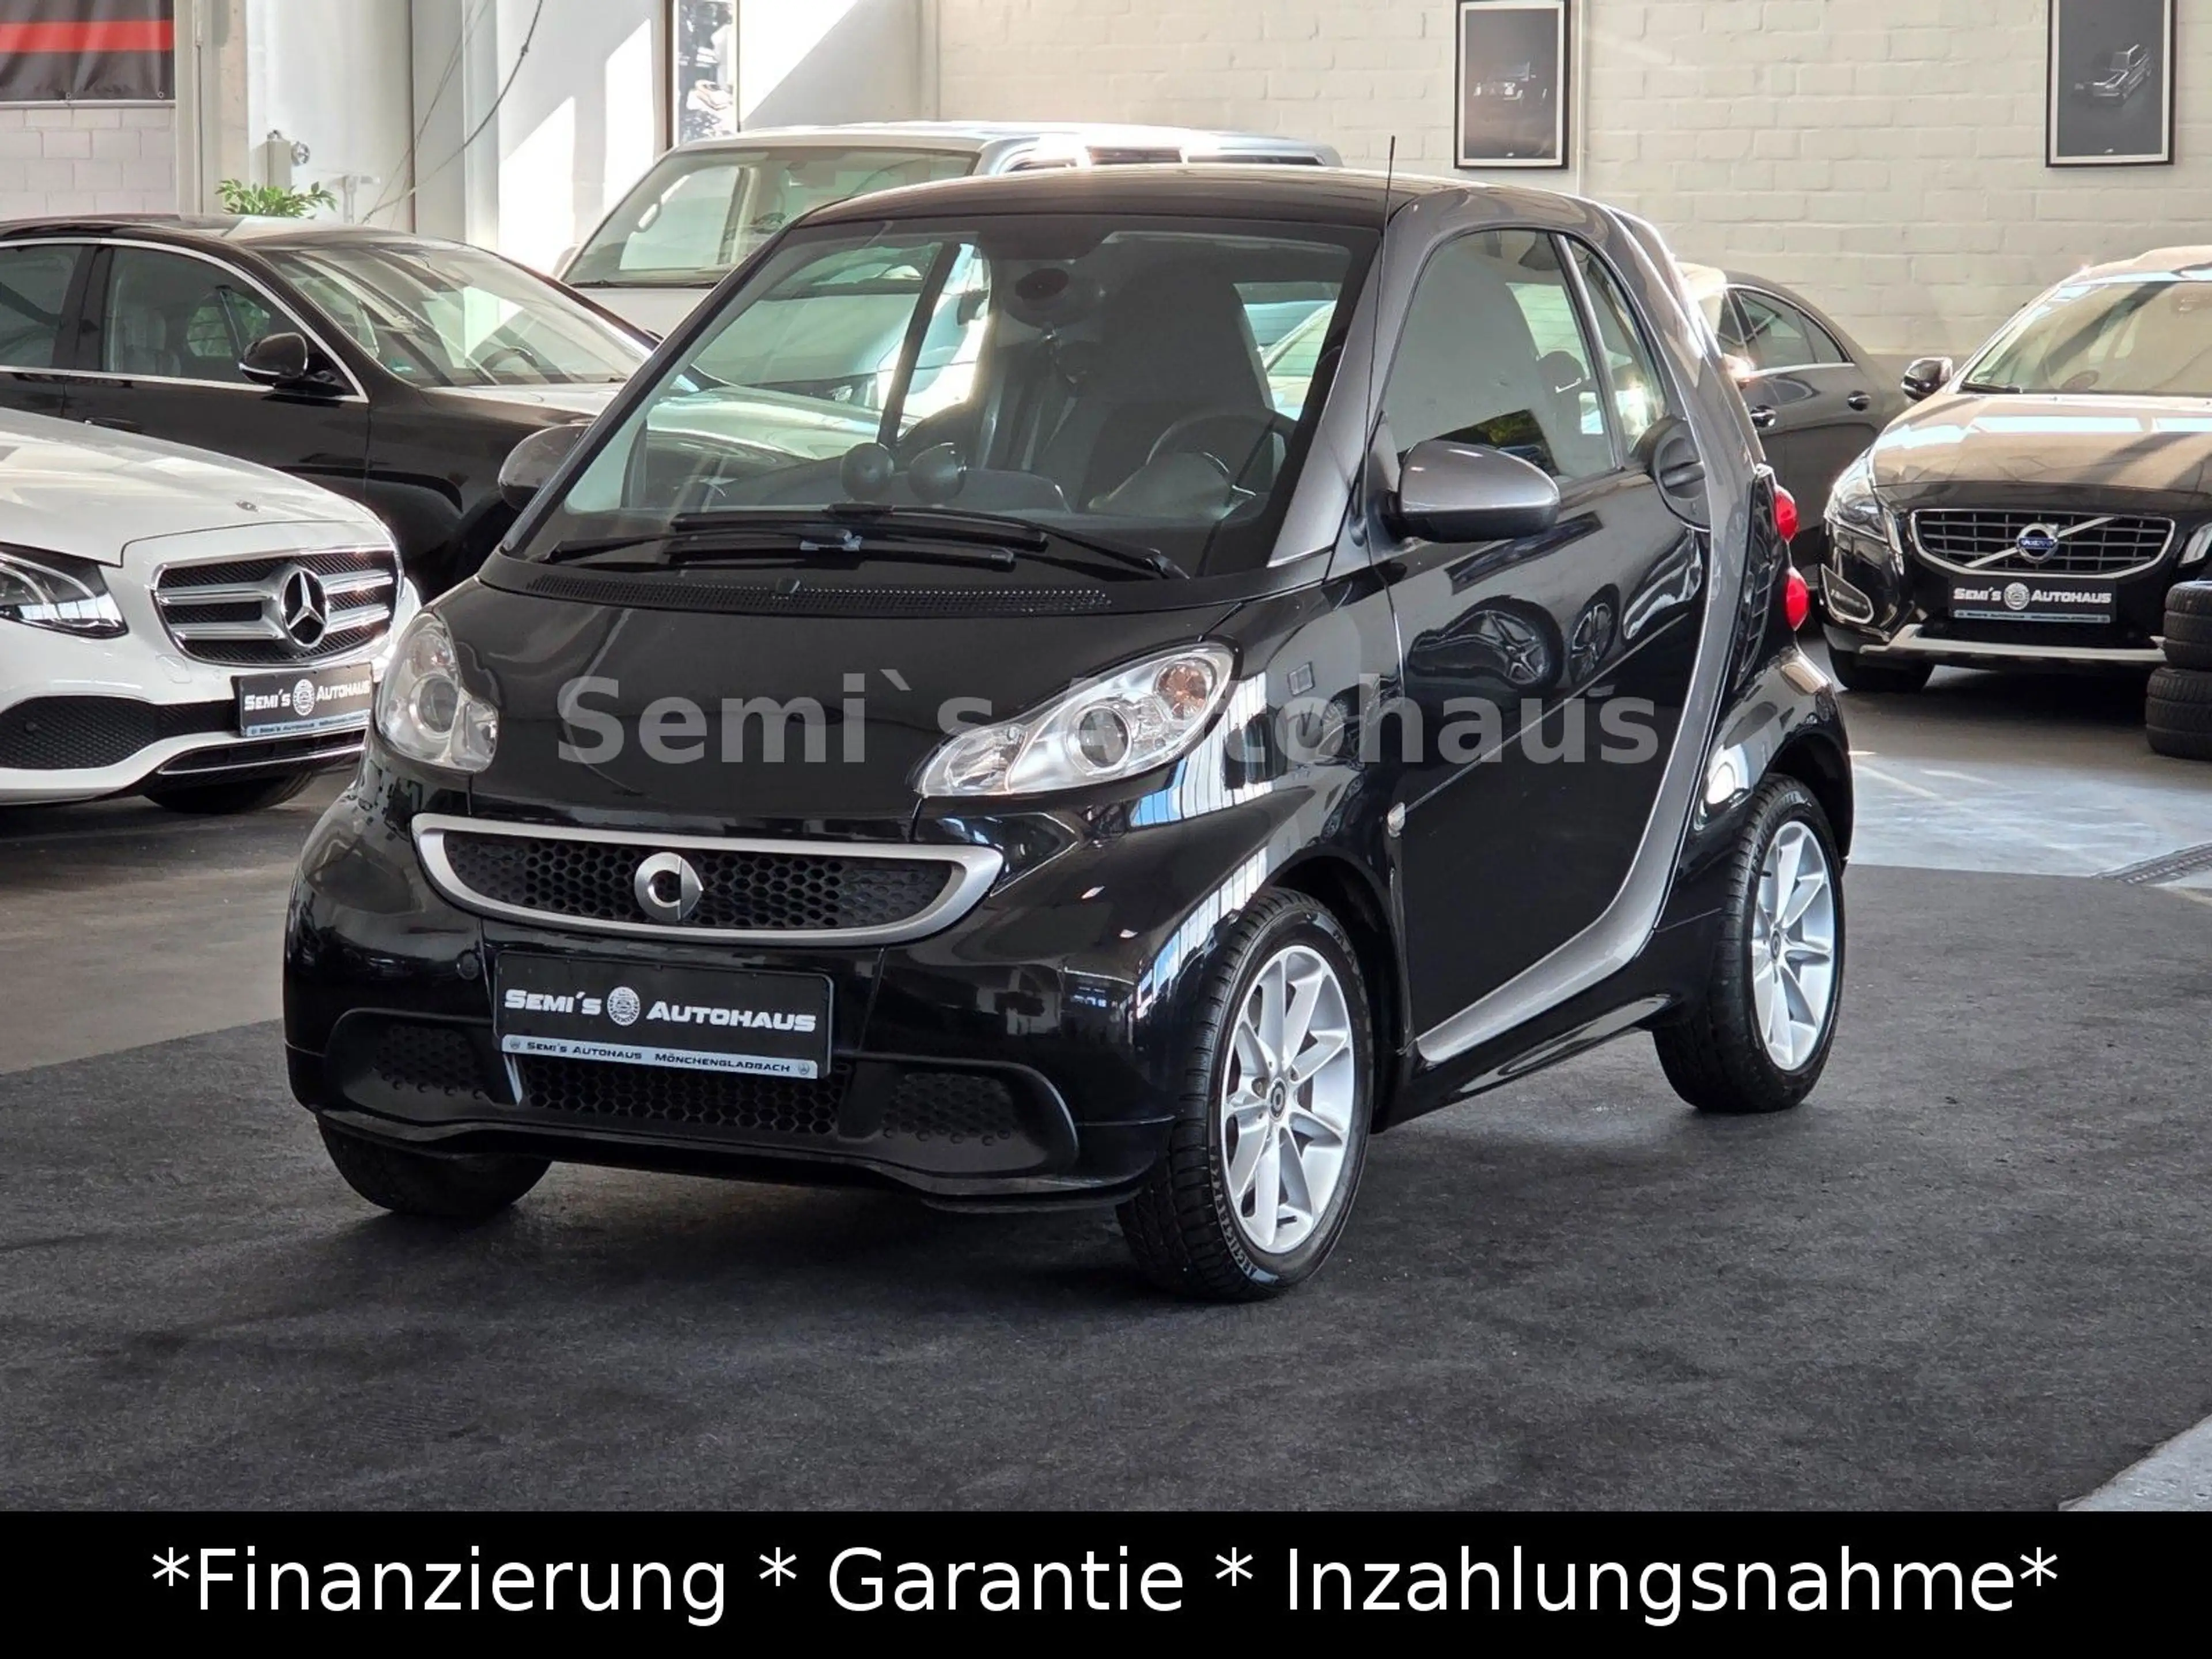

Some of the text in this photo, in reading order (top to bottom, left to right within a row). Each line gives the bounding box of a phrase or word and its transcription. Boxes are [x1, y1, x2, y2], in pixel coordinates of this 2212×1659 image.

[2031, 589, 2112, 604] AUTOHAUS
[317, 680, 371, 702] AUTOHAUS
[646, 1001, 817, 1032] AUTOHAUS
[573, 1046, 643, 1060] AUTOHAUS
[655, 1052, 791, 1073] MÖNCHENGLADBACH
